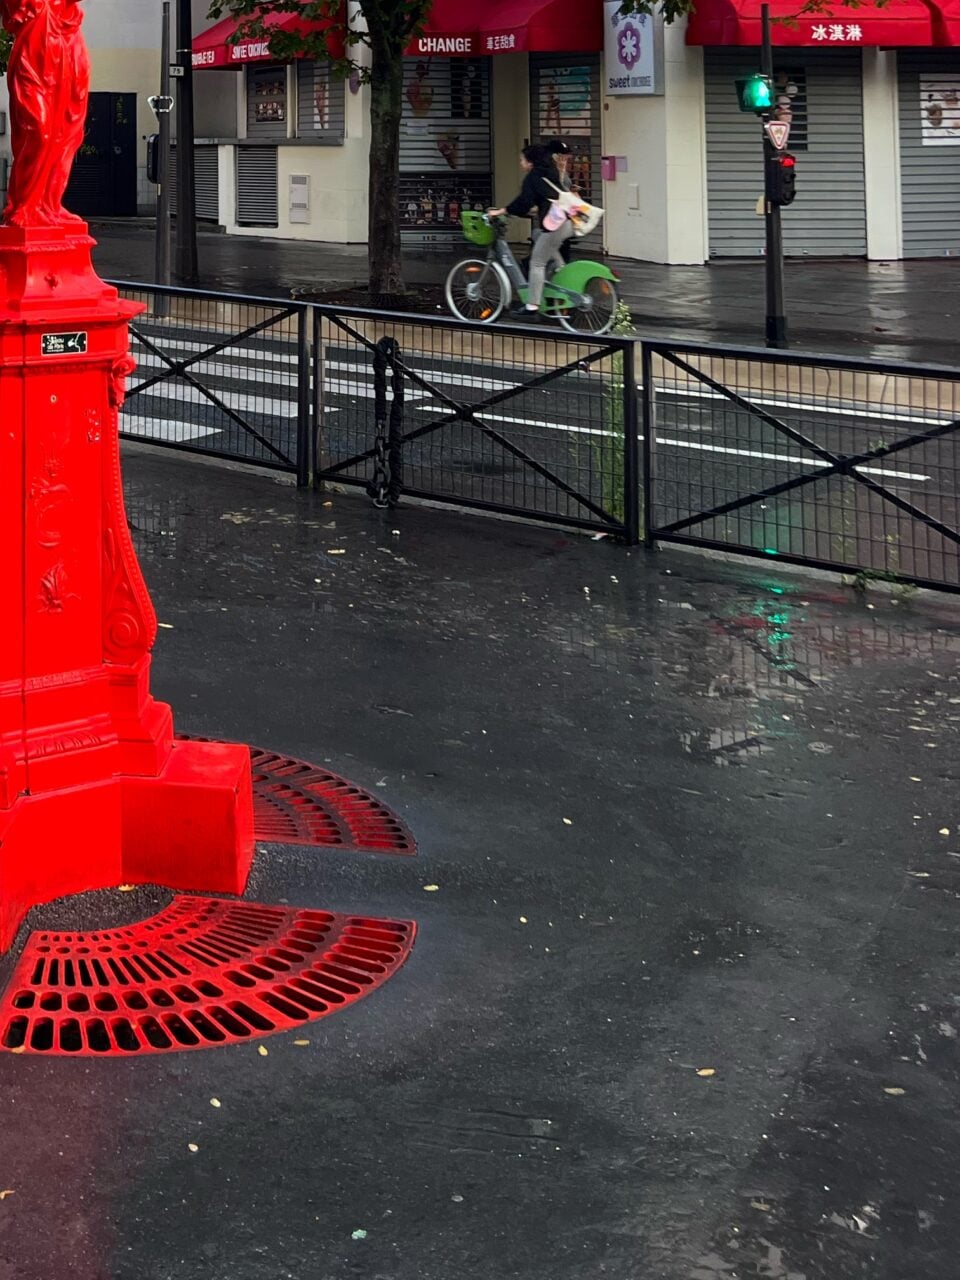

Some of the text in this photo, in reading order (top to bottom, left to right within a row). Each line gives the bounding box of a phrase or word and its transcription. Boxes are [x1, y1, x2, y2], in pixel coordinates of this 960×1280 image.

[811, 24, 863, 41] 冰淇淋
[419, 37, 472, 52] CHANGE
[609, 74, 630, 89] sweet
